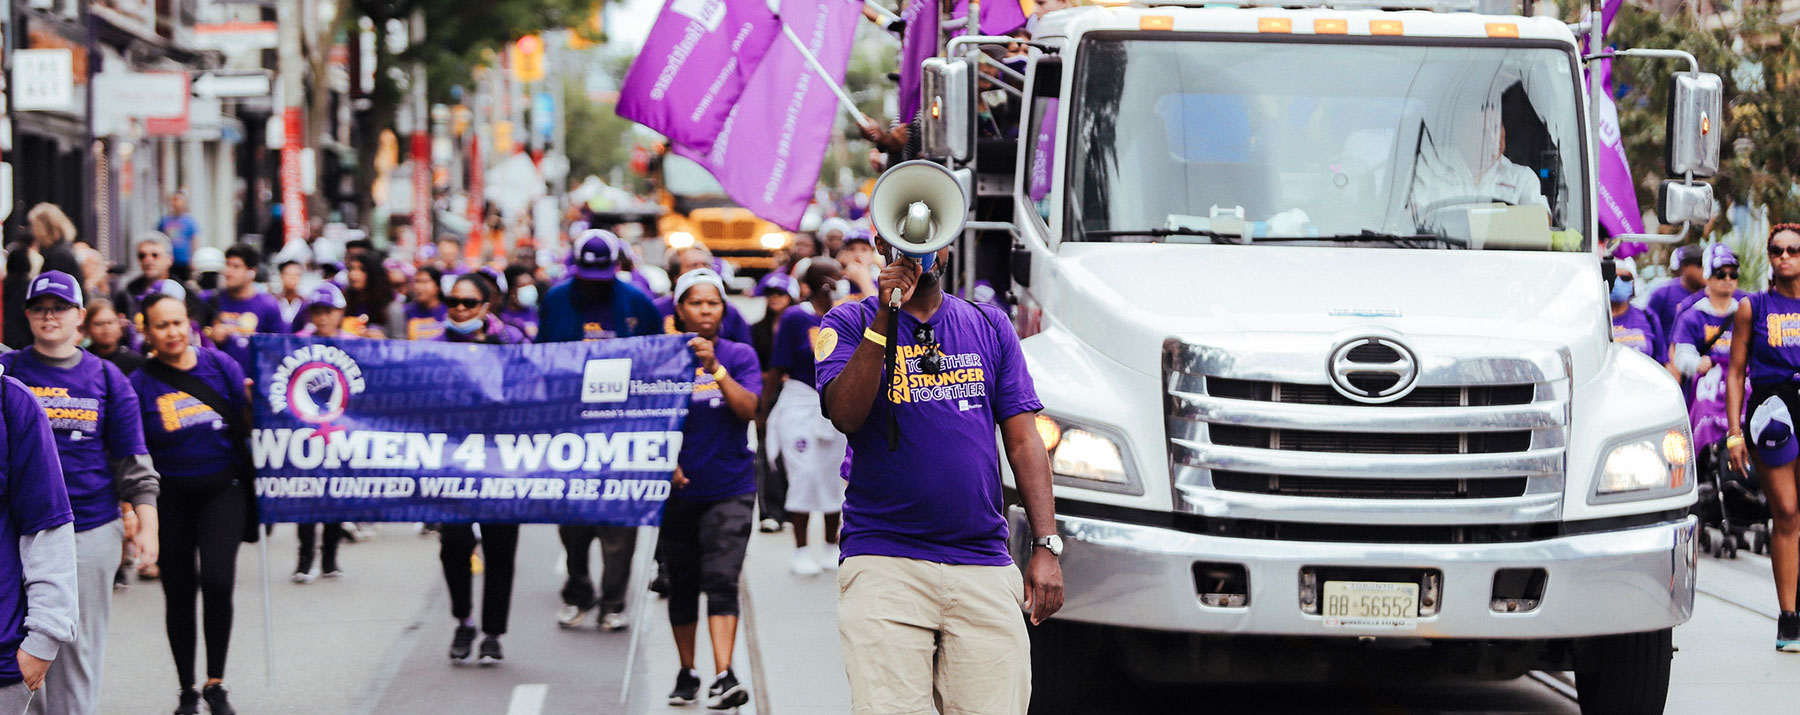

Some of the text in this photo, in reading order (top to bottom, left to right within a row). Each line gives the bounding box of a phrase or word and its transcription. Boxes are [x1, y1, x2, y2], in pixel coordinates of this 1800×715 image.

[905, 353, 982, 373] TOETHER
[268, 346, 313, 415] WOMAN
[310, 344, 366, 395] POWER
[588, 381, 623, 394] SEIU
[629, 379, 694, 396] Healthca
[909, 368, 985, 388] STRONGER
[911, 382, 986, 403] TOGETHER
[39, 397, 99, 410] OGETHER
[44, 407, 99, 421] RONGER
[251, 428, 448, 470] WOMEN
[453, 431, 487, 470] 4
[328, 476, 416, 498] UNITED
[420, 478, 481, 499] WILL
[479, 478, 566, 500] NEVER
[566, 478, 601, 500] BE
[601, 478, 671, 501] DIVID
[1360, 594, 1412, 618] 56552
